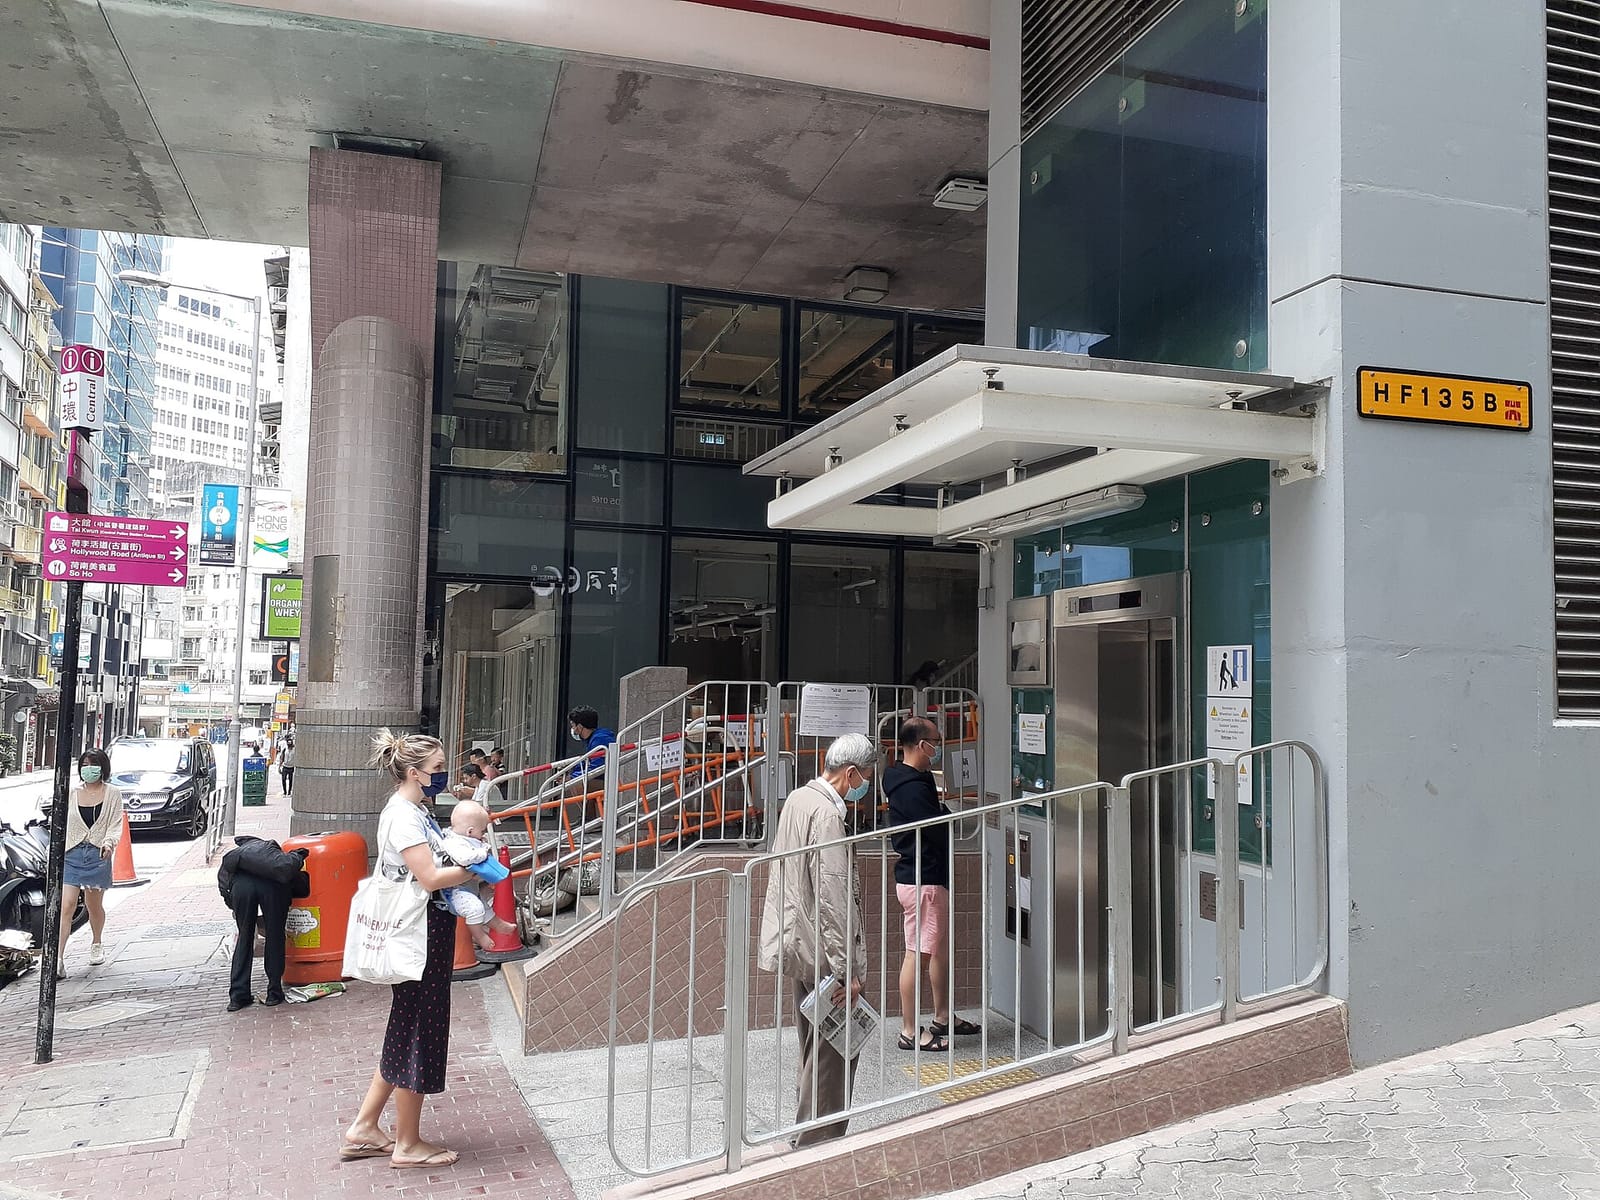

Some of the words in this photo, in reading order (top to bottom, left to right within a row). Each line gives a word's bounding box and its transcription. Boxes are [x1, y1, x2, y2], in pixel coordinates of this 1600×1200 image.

[63, 378, 78, 421] 中環
[87, 378, 96, 422] Central
[71, 518, 91, 527] 大館
[257, 515, 287, 523] HONG
[257, 522, 287, 530] KONG
[70, 548, 109, 557] Hollywood
[131, 552, 156, 560] (Antique
[70, 561, 117, 572] 荷南美食區
[271, 599, 302, 608] ORGANI
[275, 608, 301, 617] WHEY
